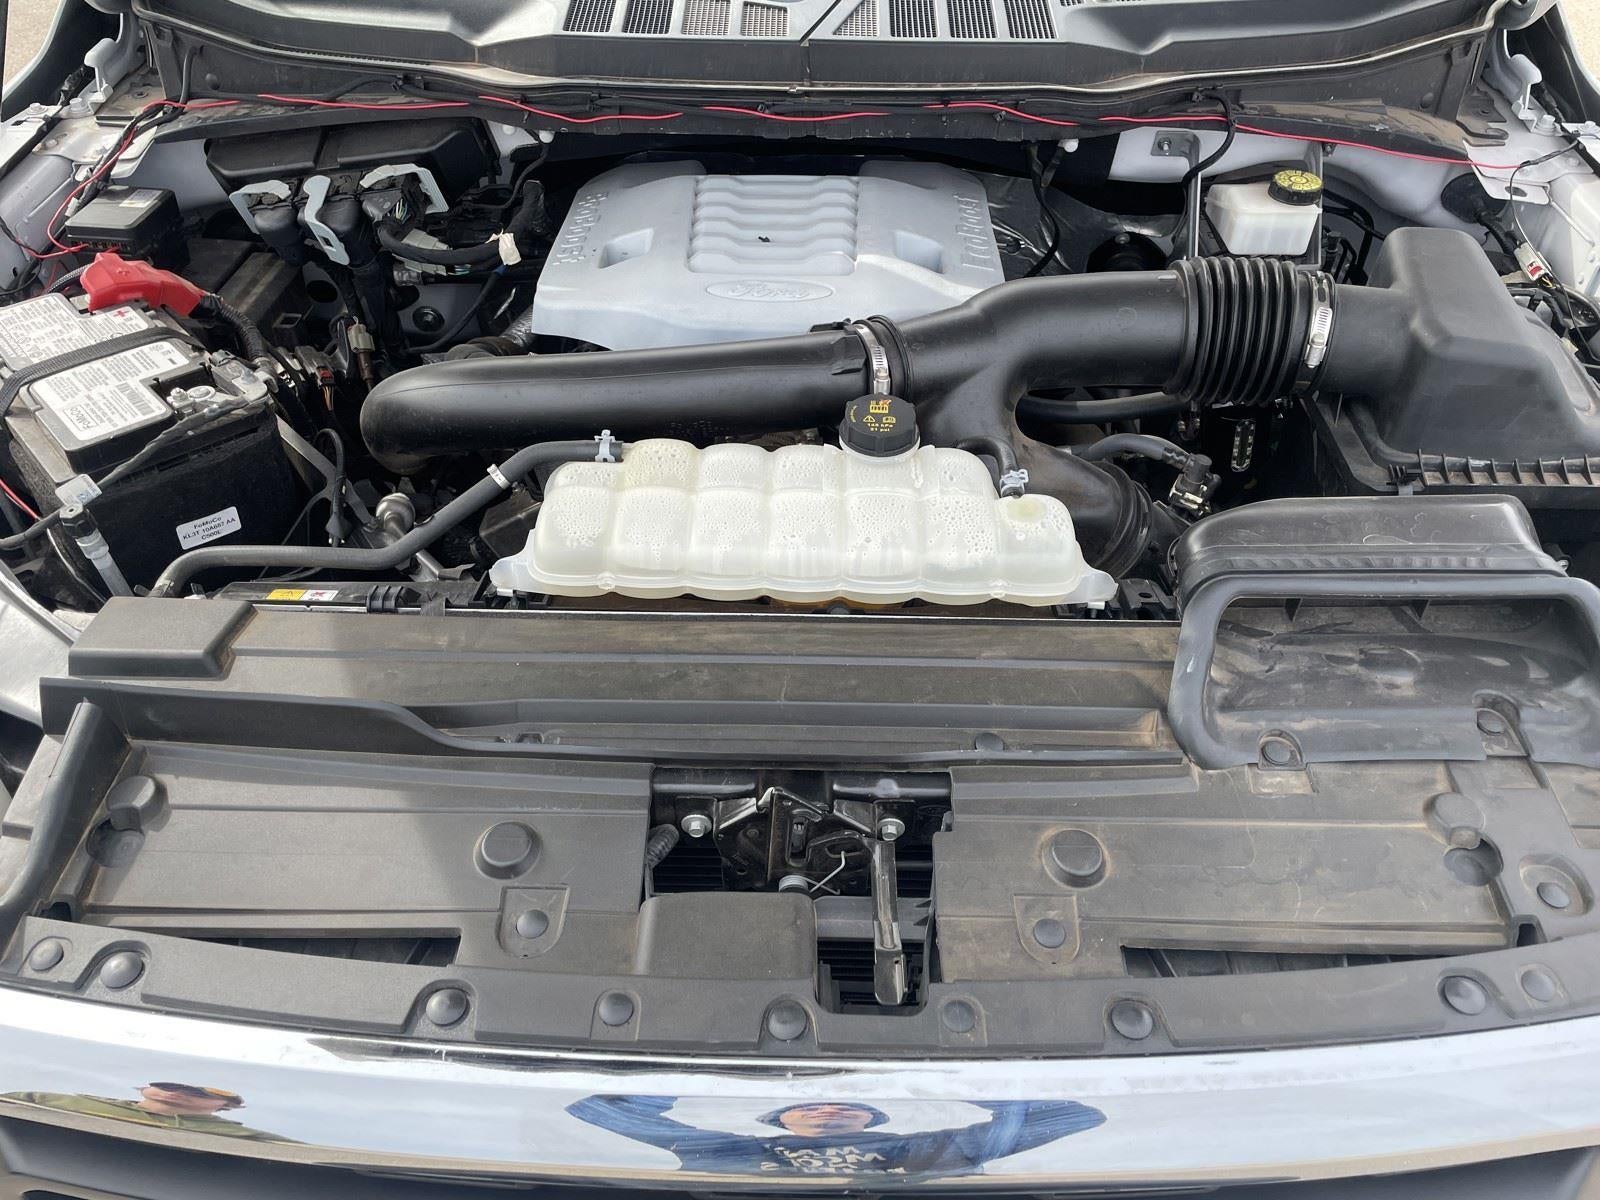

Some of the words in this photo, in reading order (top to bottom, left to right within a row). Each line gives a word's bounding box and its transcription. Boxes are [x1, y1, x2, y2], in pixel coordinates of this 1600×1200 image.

[952, 192, 996, 272] EcoBoost
[727, 280, 811, 298] Ford
[193, 517, 222, 529] FoMoCo
